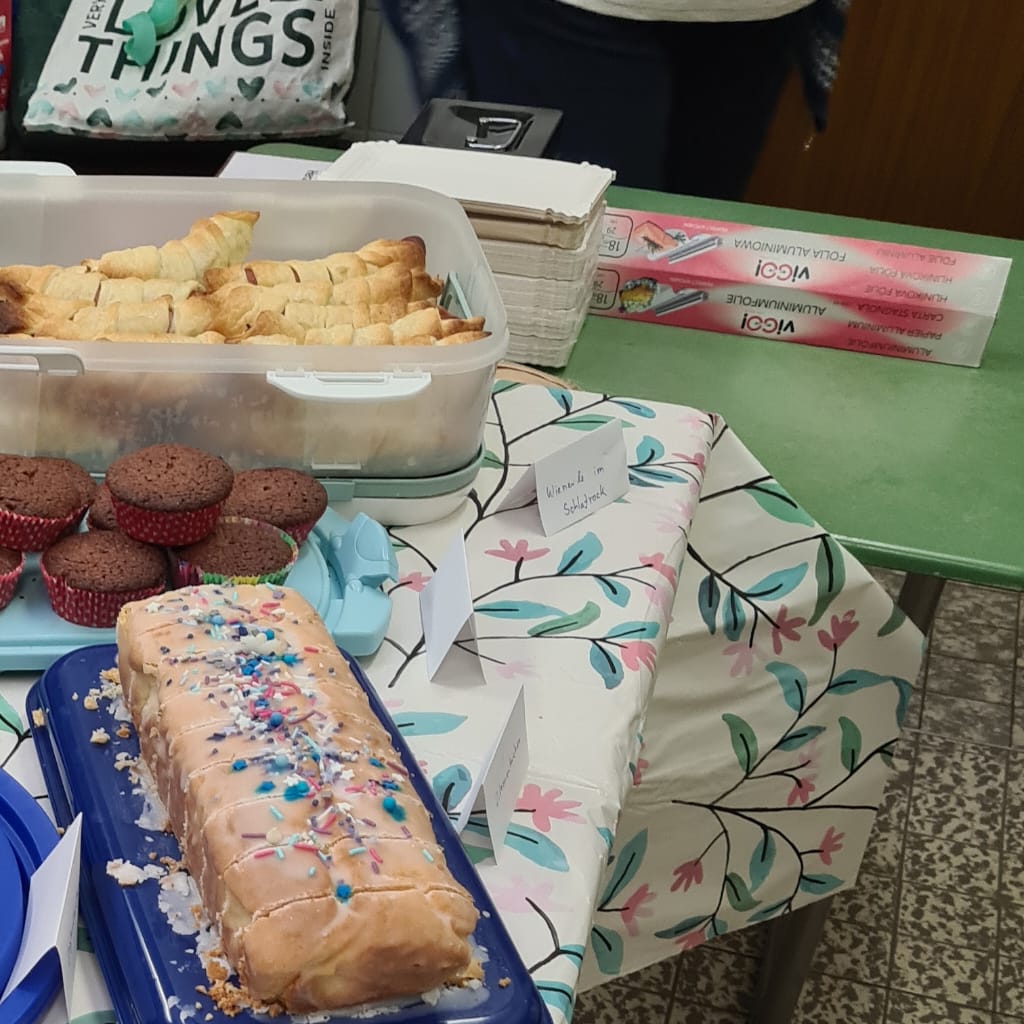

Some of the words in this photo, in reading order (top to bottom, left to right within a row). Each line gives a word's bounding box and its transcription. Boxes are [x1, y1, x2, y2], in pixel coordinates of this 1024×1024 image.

[78, 8, 315, 82] THINGS
[321, 8, 335, 70] INSIDE
[734, 239, 812, 257] ALUMINIOWA
[813, 250, 847, 262] FOLIA
[726, 293, 827, 316] ALUMINIUMFOLIE
[912, 310, 944, 322] CARTA
[847, 320, 903, 336] ALUMINIUM
[907, 328, 942, 340] PAPIER
[847, 338, 933, 357] ALUMINIUMFOLIE
